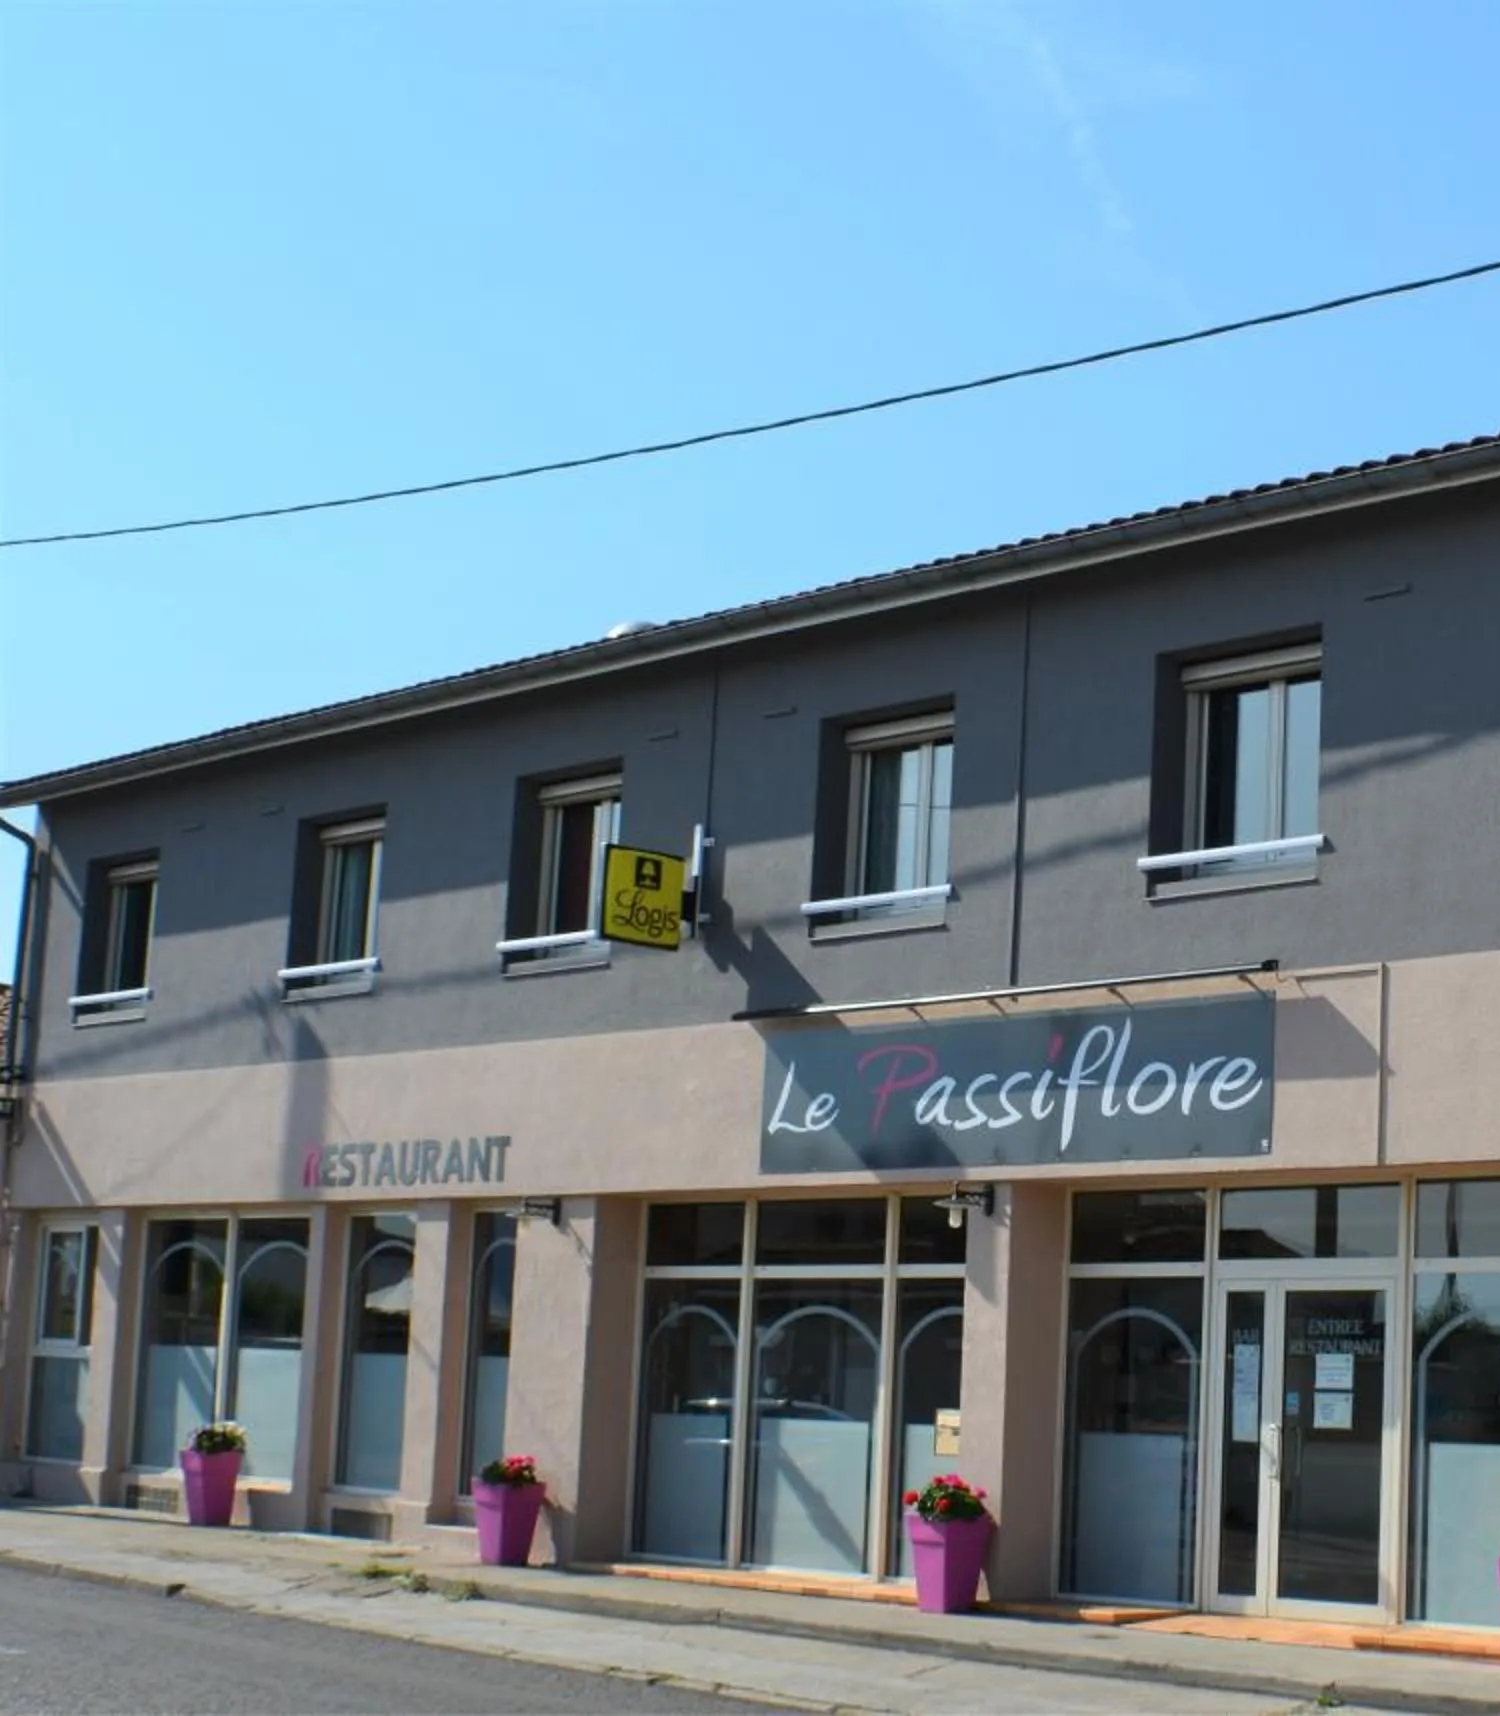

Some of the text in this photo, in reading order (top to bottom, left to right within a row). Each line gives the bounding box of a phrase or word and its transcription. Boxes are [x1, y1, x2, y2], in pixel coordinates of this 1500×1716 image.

[612, 889, 678, 938] Logis
[767, 1017, 1264, 1152] Le Passiflore
[303, 1135, 511, 1188] RESTAURANT
